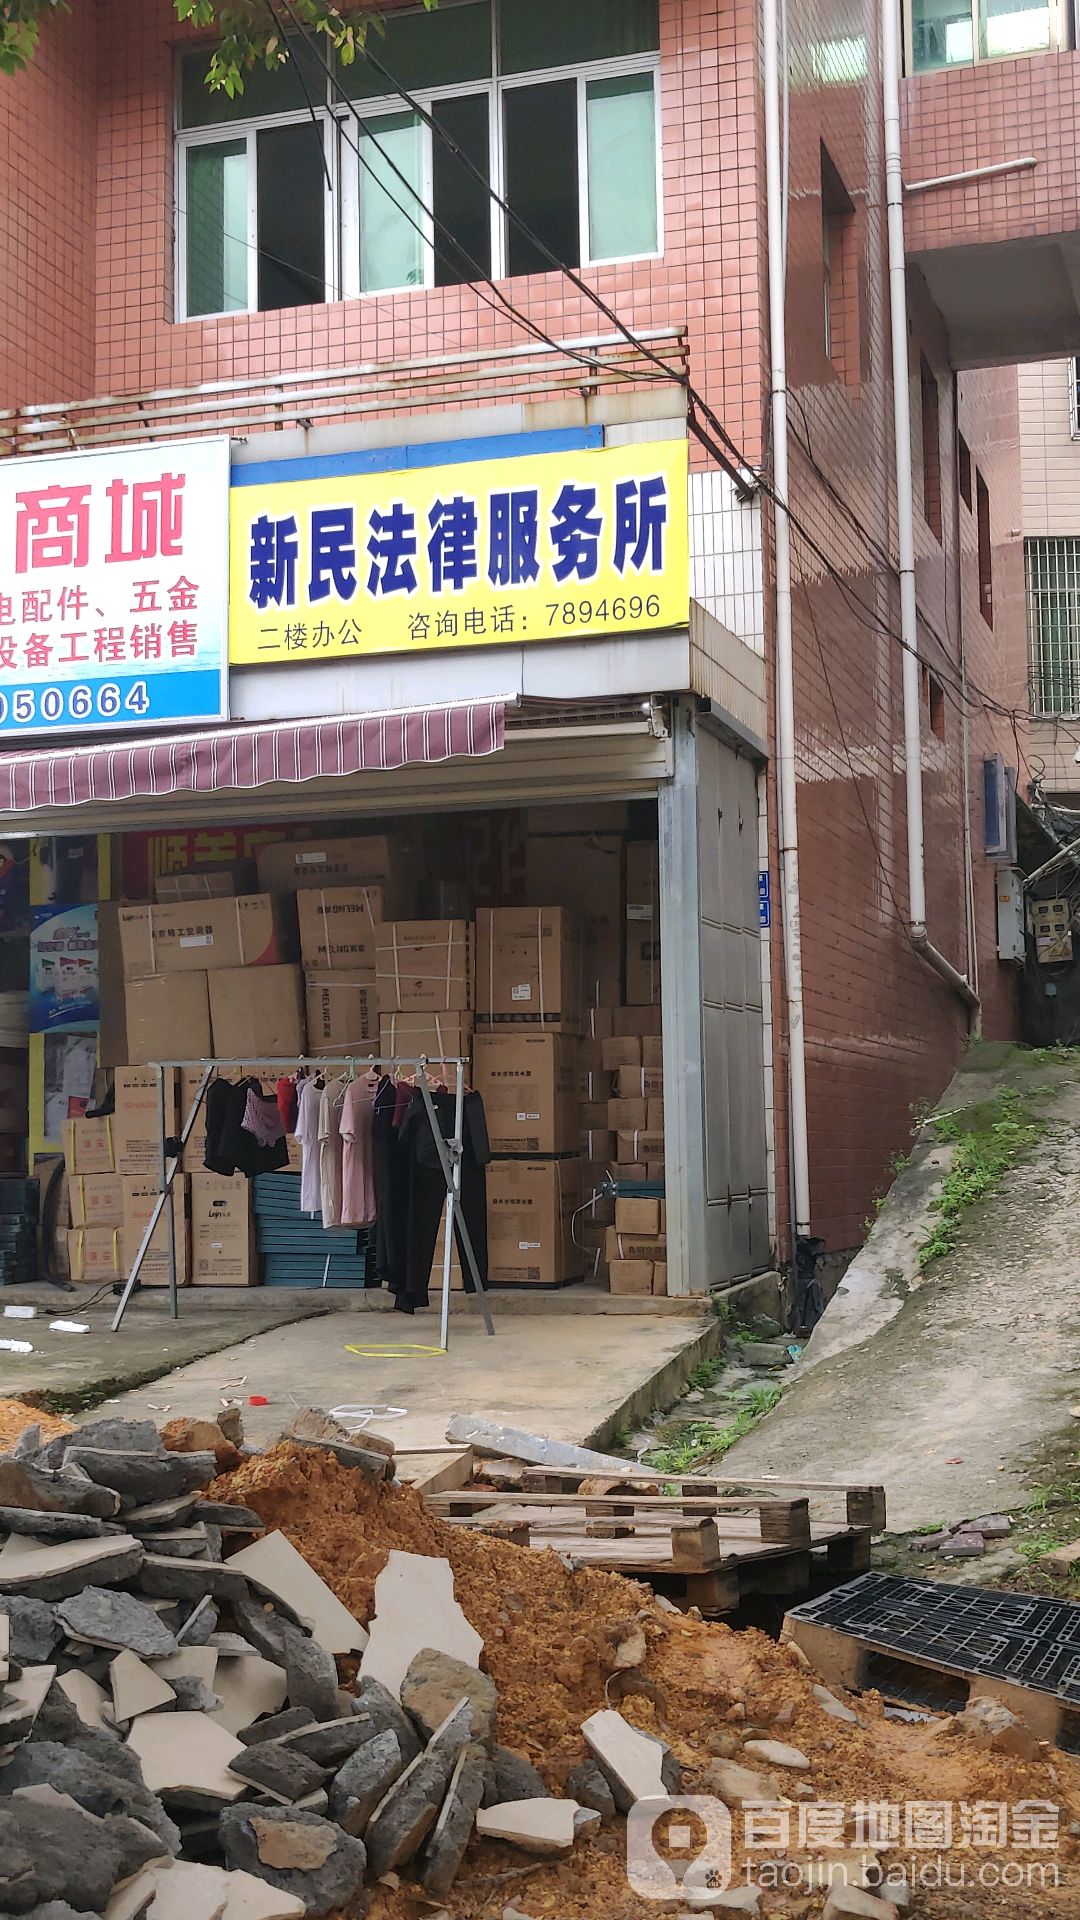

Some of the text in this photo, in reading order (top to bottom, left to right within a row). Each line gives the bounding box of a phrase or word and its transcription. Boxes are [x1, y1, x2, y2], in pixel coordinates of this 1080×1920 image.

[15, 472, 186, 574] 商城
[249, 475, 667, 609] 新民法律服务所
[258, 618, 362, 651] 二楼办公
[0, 682, 149, 721] 50664
